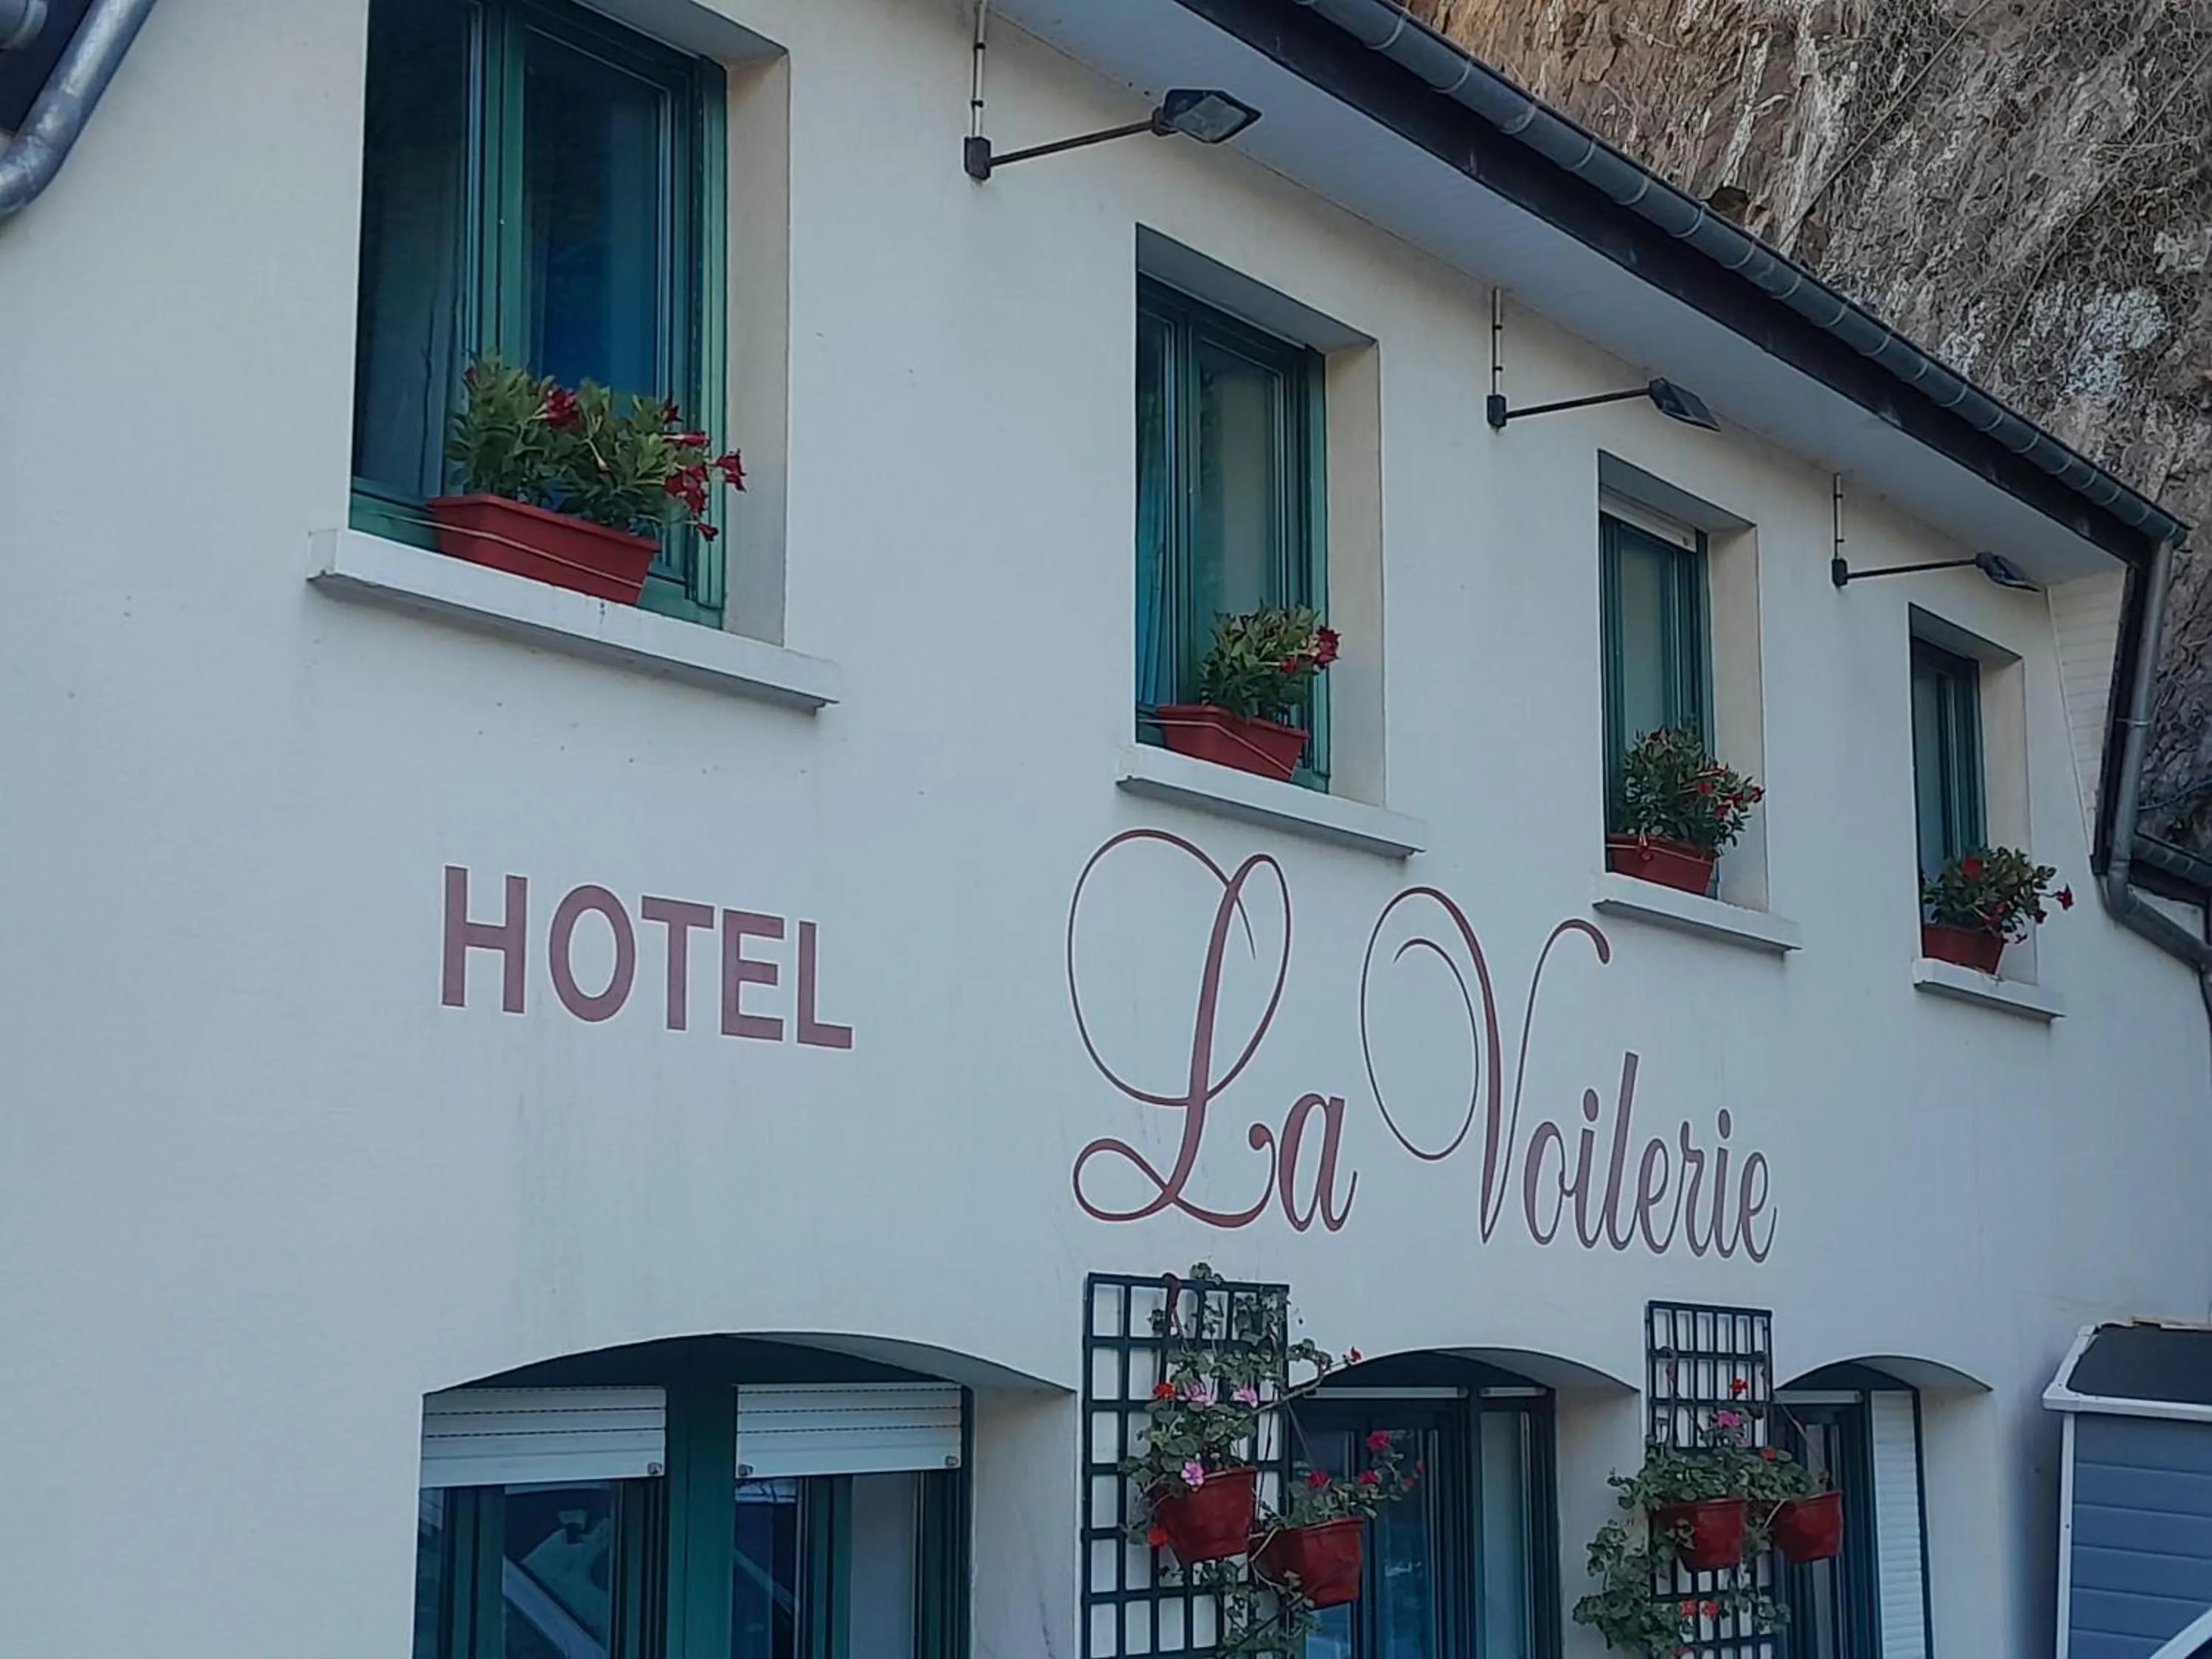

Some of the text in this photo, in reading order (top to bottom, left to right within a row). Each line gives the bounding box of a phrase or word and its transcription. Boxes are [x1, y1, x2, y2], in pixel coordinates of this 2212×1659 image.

[442, 866, 852, 1048] HOTEL
[1068, 830, 1777, 1263] La Voilerie
